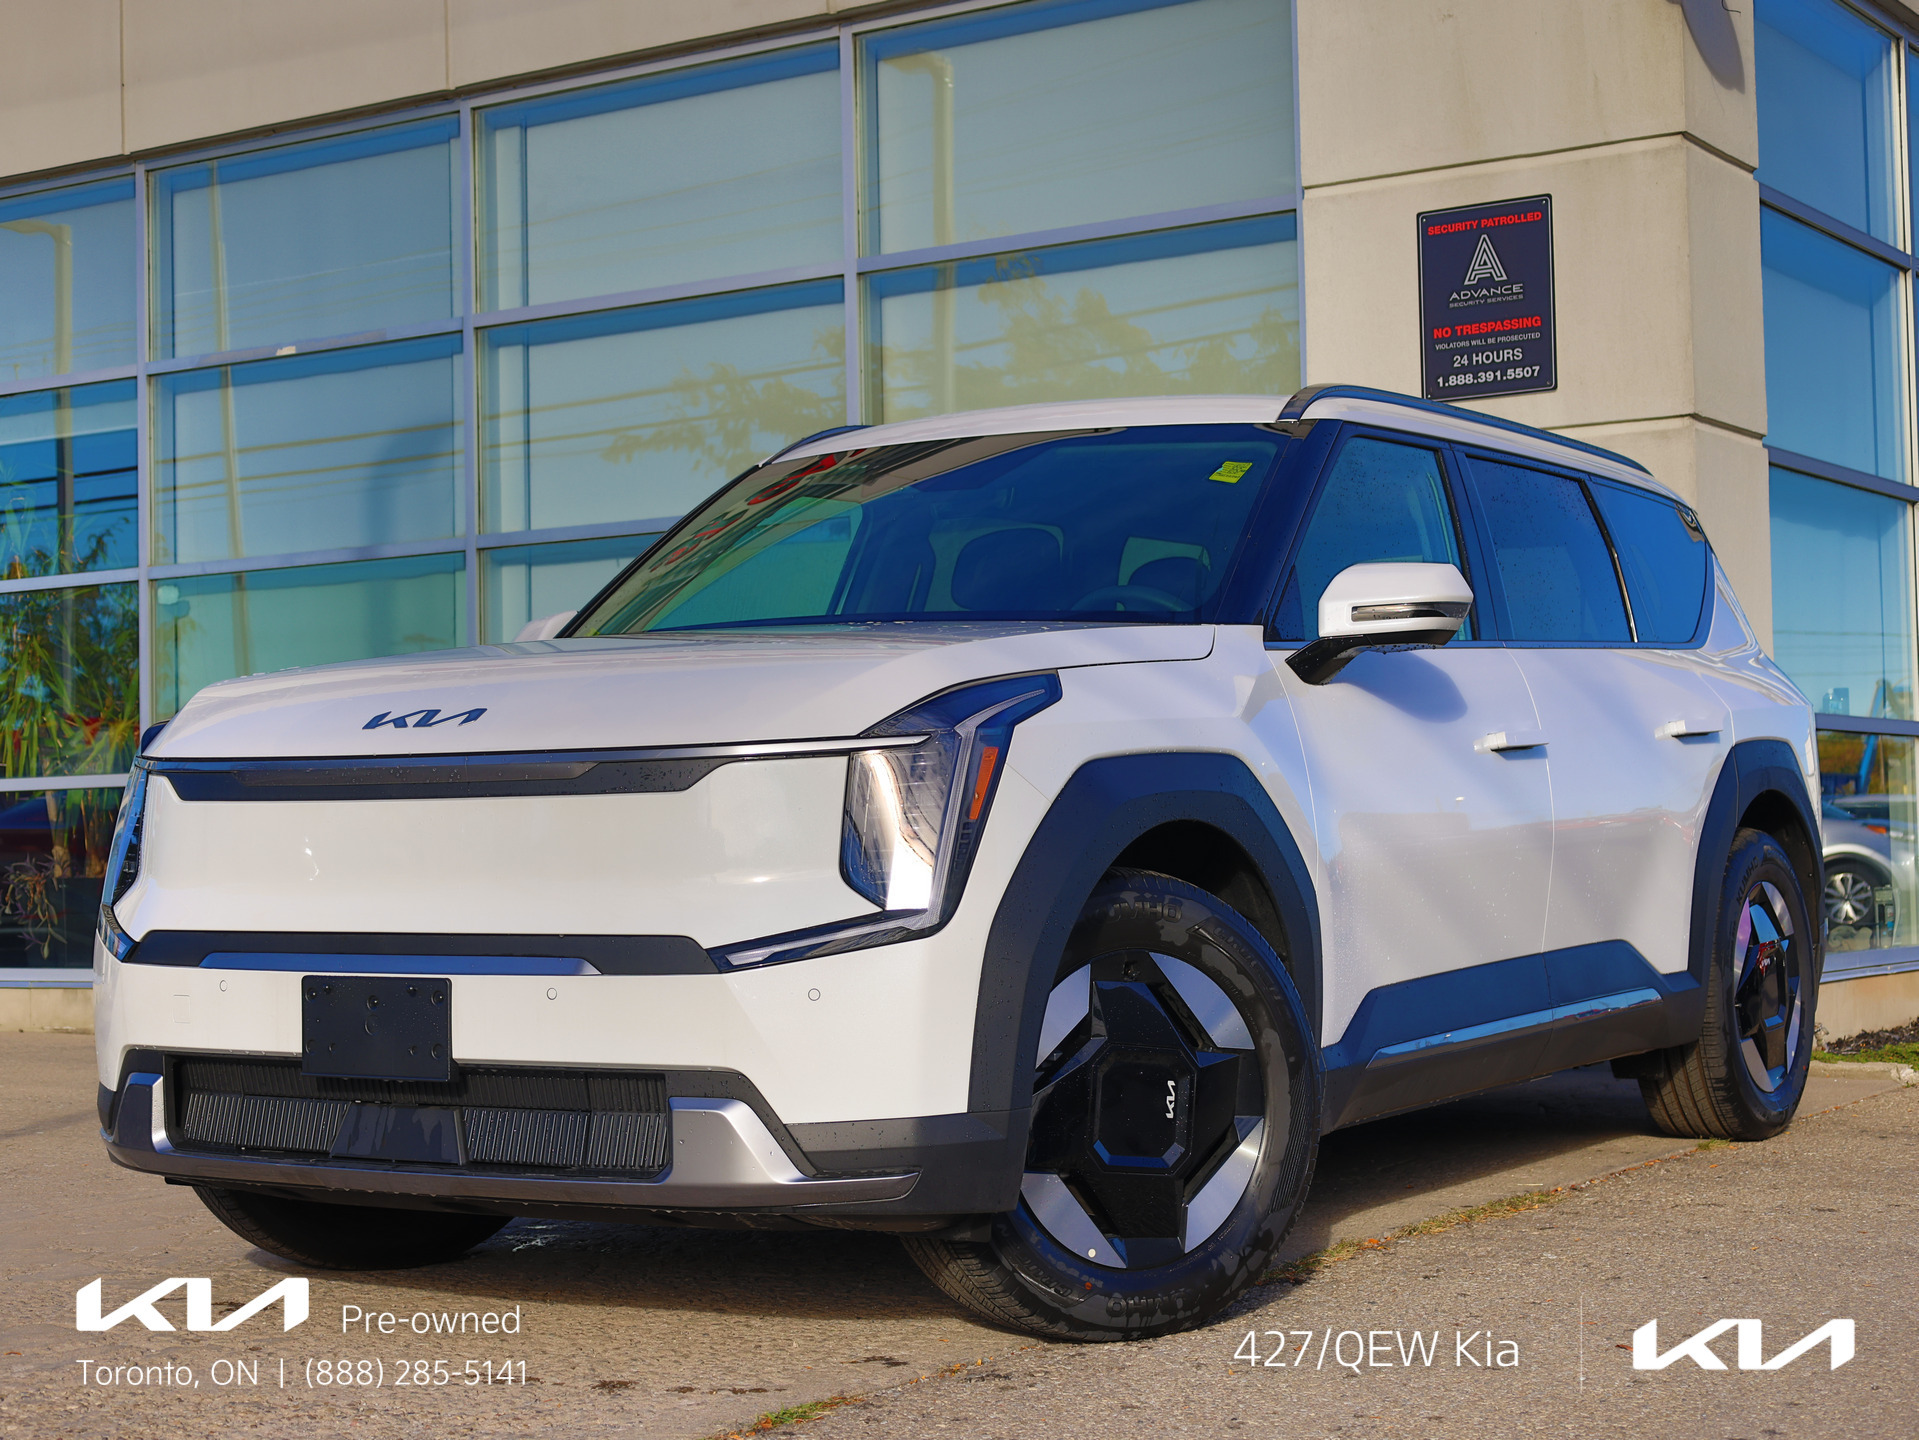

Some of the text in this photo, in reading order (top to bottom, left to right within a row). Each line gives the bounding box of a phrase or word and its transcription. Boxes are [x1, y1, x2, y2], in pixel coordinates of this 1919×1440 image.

[1427, 211, 1542, 236] SECURITY PATROLLED
[1449, 283, 1524, 302] ADVANCE
[1449, 294, 1524, 309] SECURITY SERVICES
[1433, 316, 1542, 339] NO TRESPASSING
[1435, 340, 1470, 351] VIOLATORS
[1470, 338, 1486, 346] WILL
[1497, 332, 1541, 343] PROSECUTED
[1453, 348, 1523, 368] 24 HOURS
[1437, 365, 1540, 388] 1.888.391.5507
[361, 707, 488, 730] KIA
[1165, 1080, 1176, 1119] KIA
